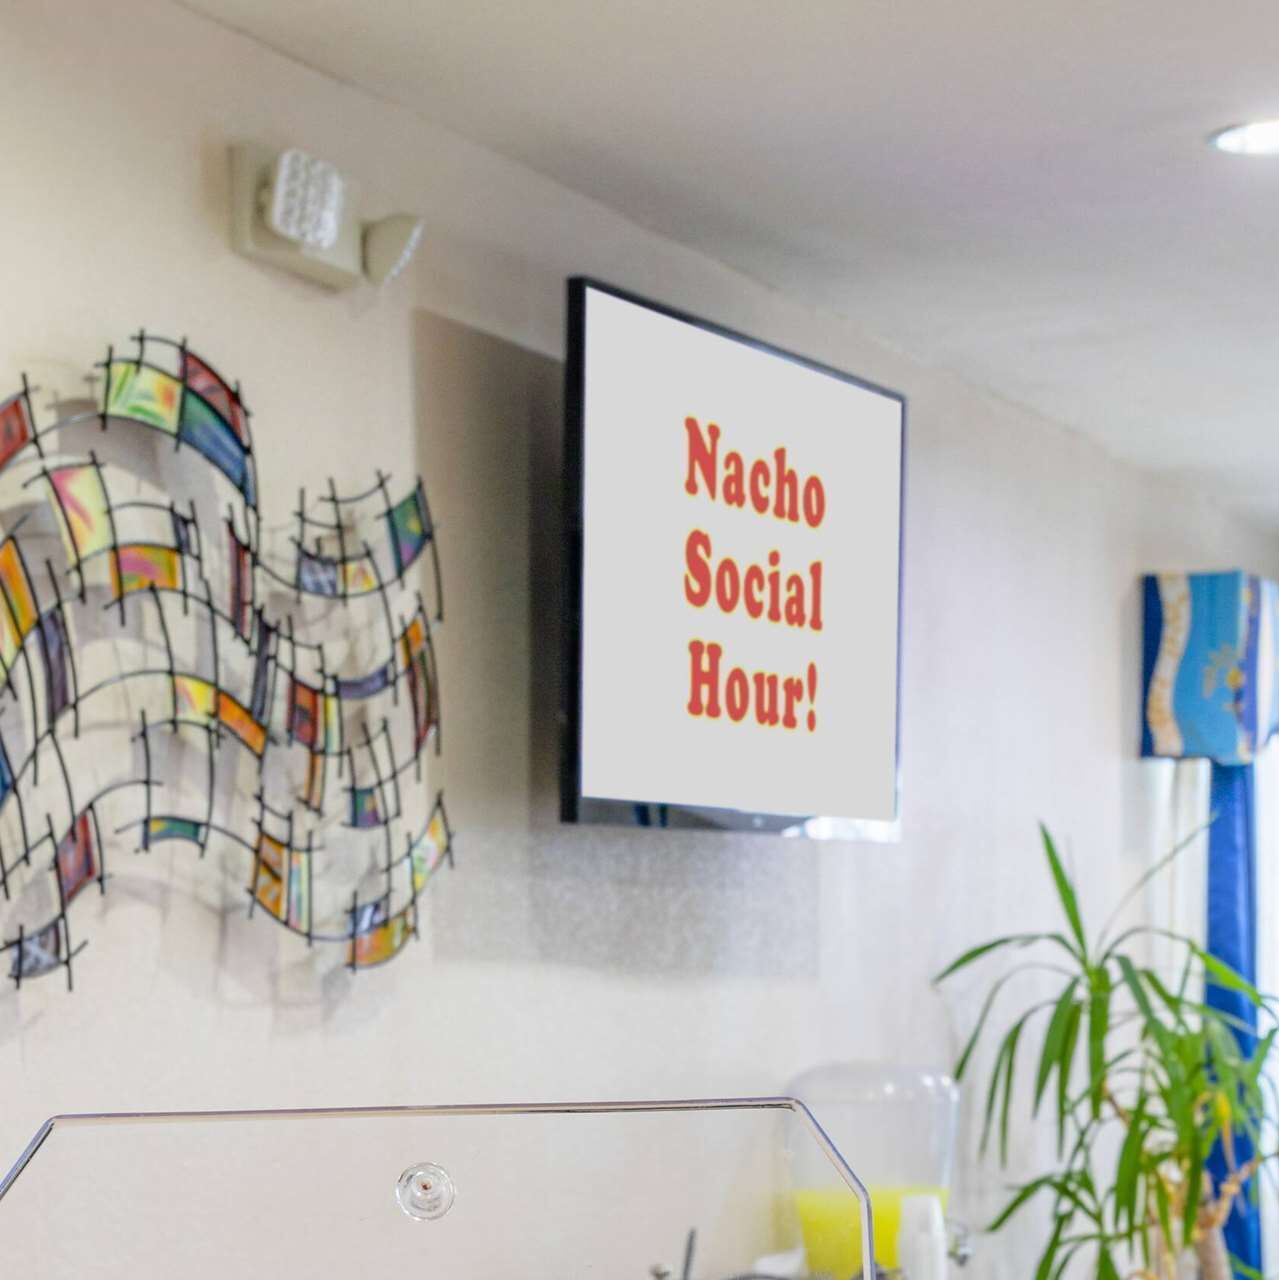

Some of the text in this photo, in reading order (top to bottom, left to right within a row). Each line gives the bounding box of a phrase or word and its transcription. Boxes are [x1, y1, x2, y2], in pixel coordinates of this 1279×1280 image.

[683, 415, 826, 530] Nacho
[683, 528, 824, 632] Social
[687, 638, 819, 732] Hour!
